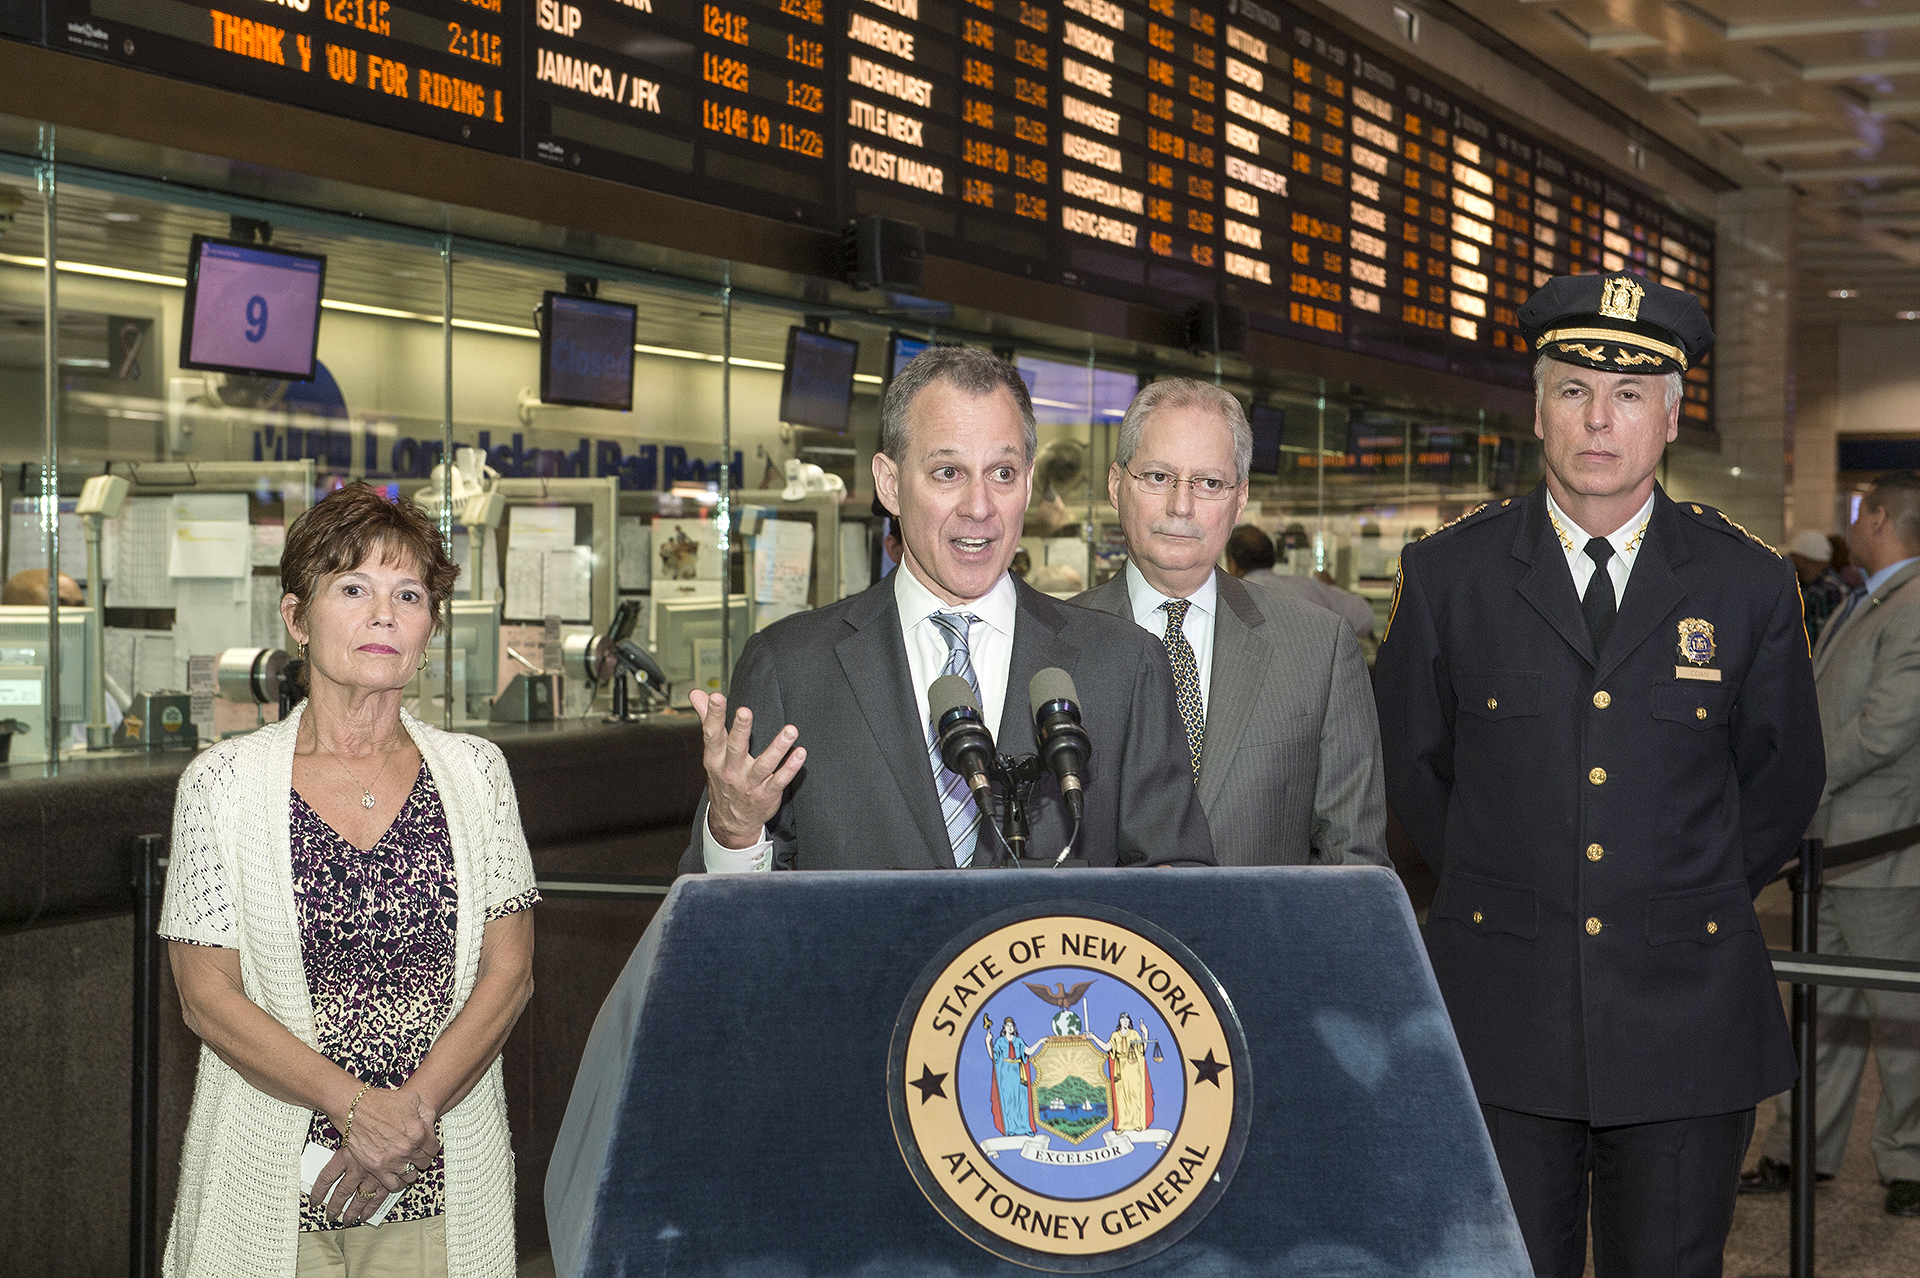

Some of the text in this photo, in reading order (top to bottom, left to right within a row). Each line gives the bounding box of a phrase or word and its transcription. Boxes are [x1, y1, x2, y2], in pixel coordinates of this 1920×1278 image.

[847, 13, 914, 62] AWRENCE
[210, 9, 285, 66] THANK
[367, 54, 409, 98] FOR
[419, 68, 485, 118] RIDING
[536, 47, 615, 101] JAMAICA
[629, 77, 661, 114] JFK
[847, 55, 933, 109] INDENHURST
[847, 99, 886, 136] ITTLE
[848, 142, 897, 181] OCUST
[246, 295, 268, 343] 9
[551, 338, 631, 380] Closed
[932, 932, 1200, 1036] STATE OF NEW YORK
[1034, 1146, 1122, 1163] EXCELSIOR
[941, 1143, 1211, 1240] ATTORNEY GENERAL
